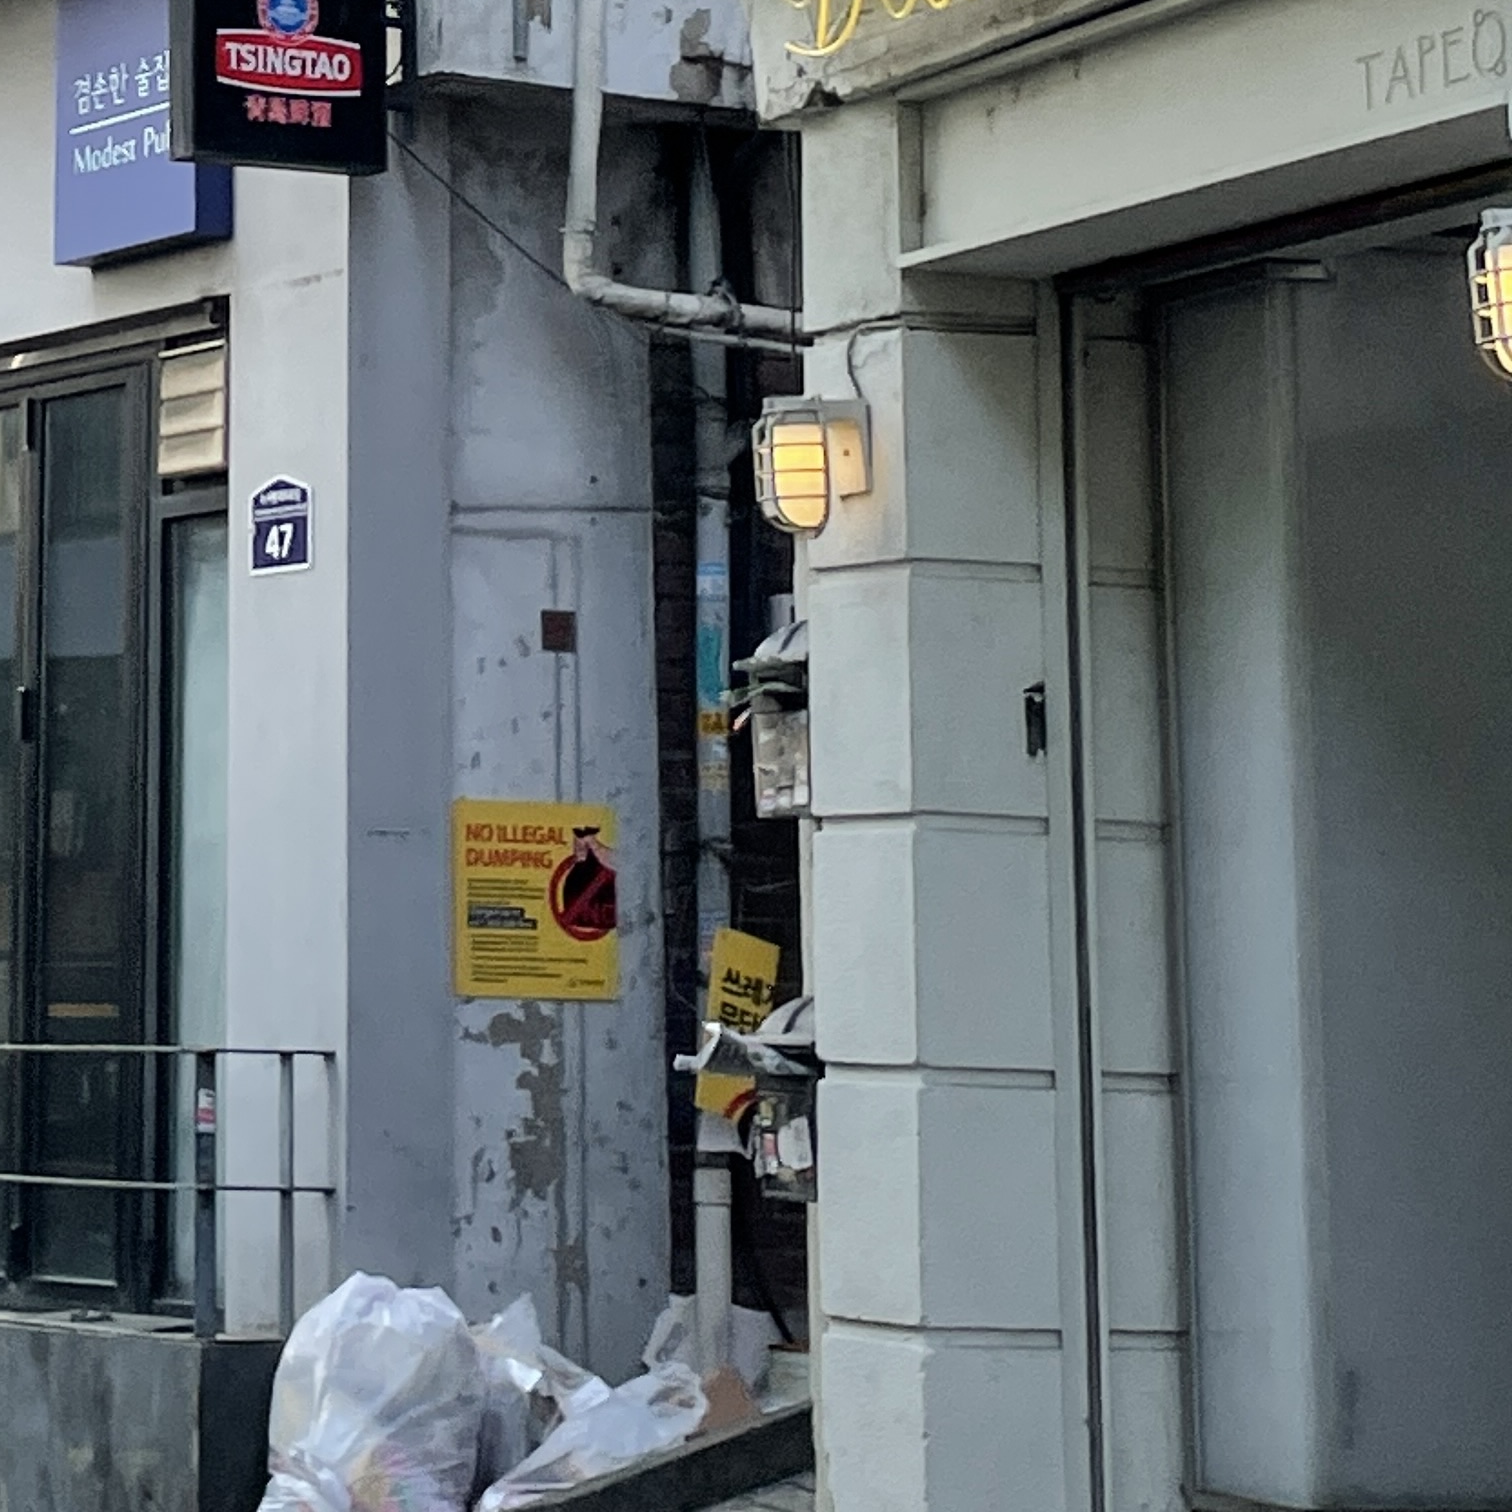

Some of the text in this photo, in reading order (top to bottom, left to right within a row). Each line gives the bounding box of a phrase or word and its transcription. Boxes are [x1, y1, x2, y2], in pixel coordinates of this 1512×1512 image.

[224, 41, 352, 82] TSINGTAO
[73, 50, 170, 115] 겸손한 술집
[73, 135, 137, 175] Modest
[265, 522, 294, 560] 47
[465, 823, 568, 846] NO ILLEGAL
[465, 848, 554, 869] DUMPING
